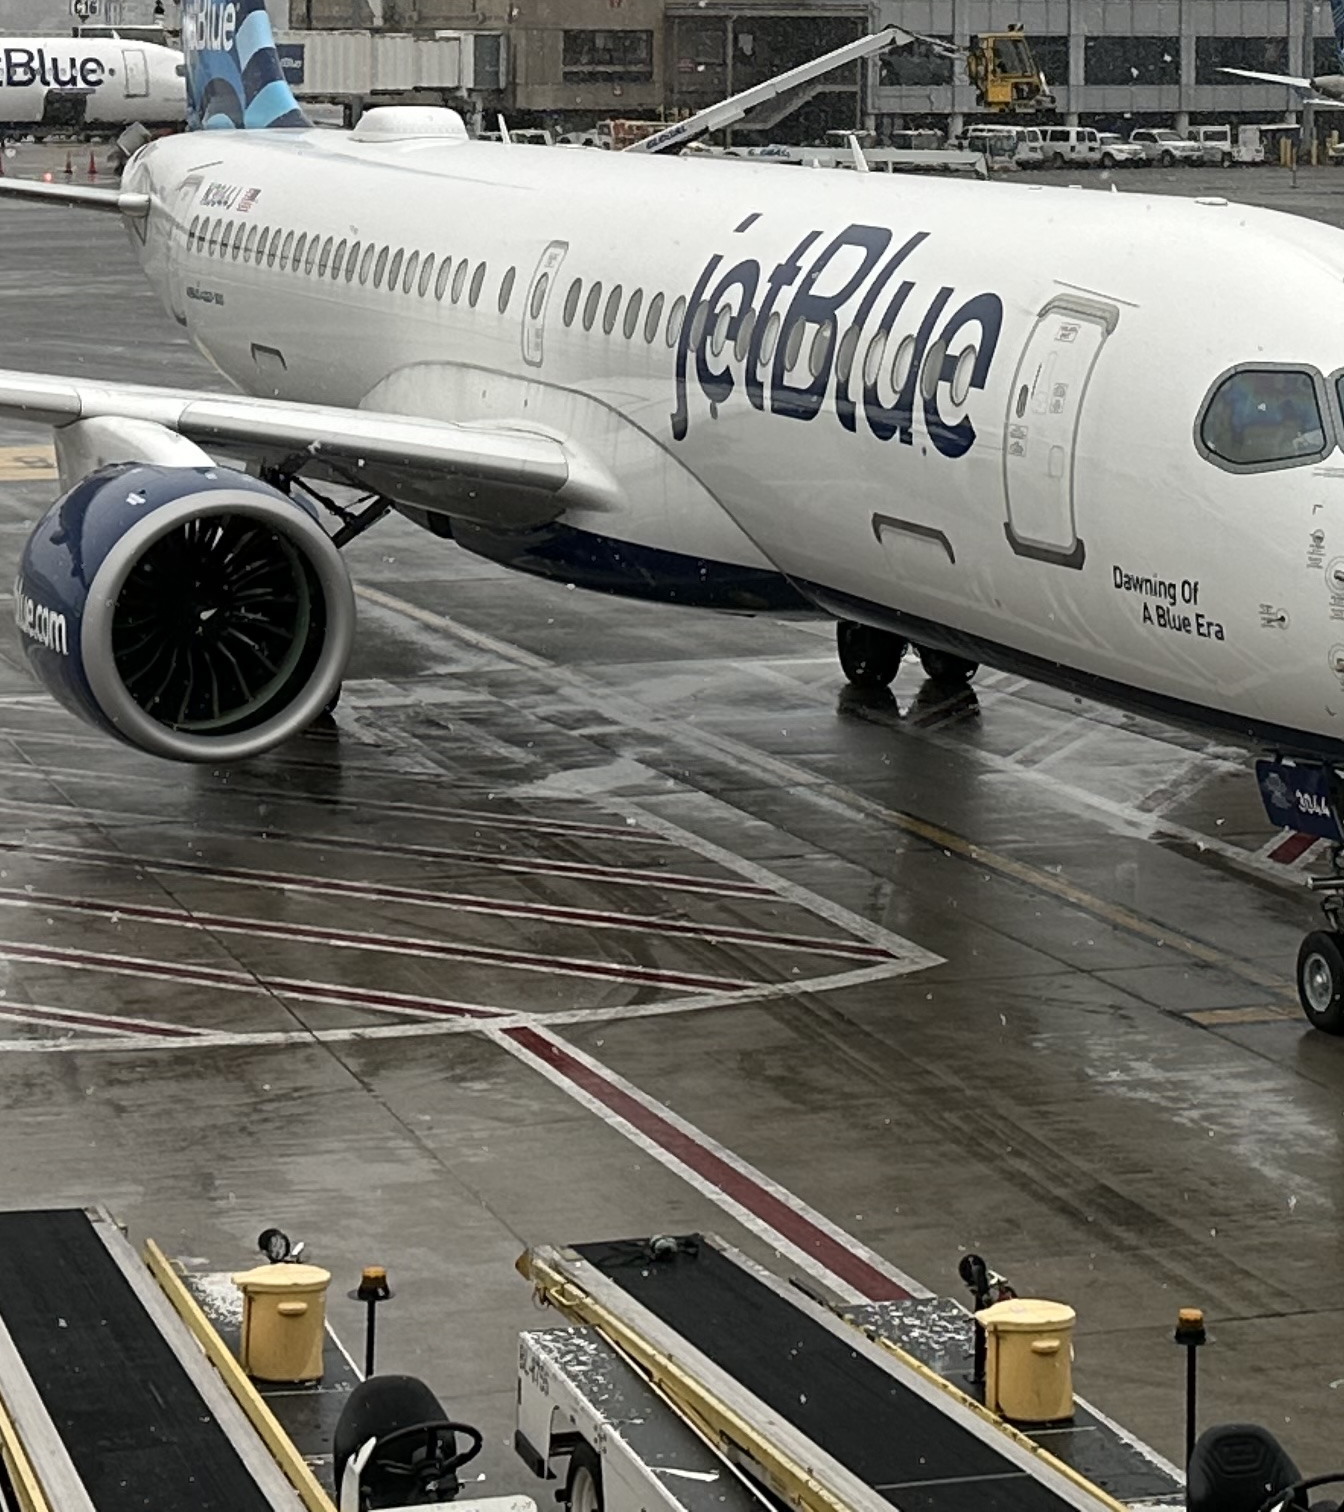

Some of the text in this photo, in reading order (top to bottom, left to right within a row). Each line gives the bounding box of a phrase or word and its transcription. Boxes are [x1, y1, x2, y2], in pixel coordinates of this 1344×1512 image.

[74, 0, 97, 14] C16
[670, 213, 1003, 458] jetBlue
[1113, 565, 1199, 607] Dawning Of
[1143, 602, 1155, 625] A
[1156, 605, 1192, 635] Blue
[1195, 612, 1225, 641] Era
[1296, 789, 1331, 818] 3044
